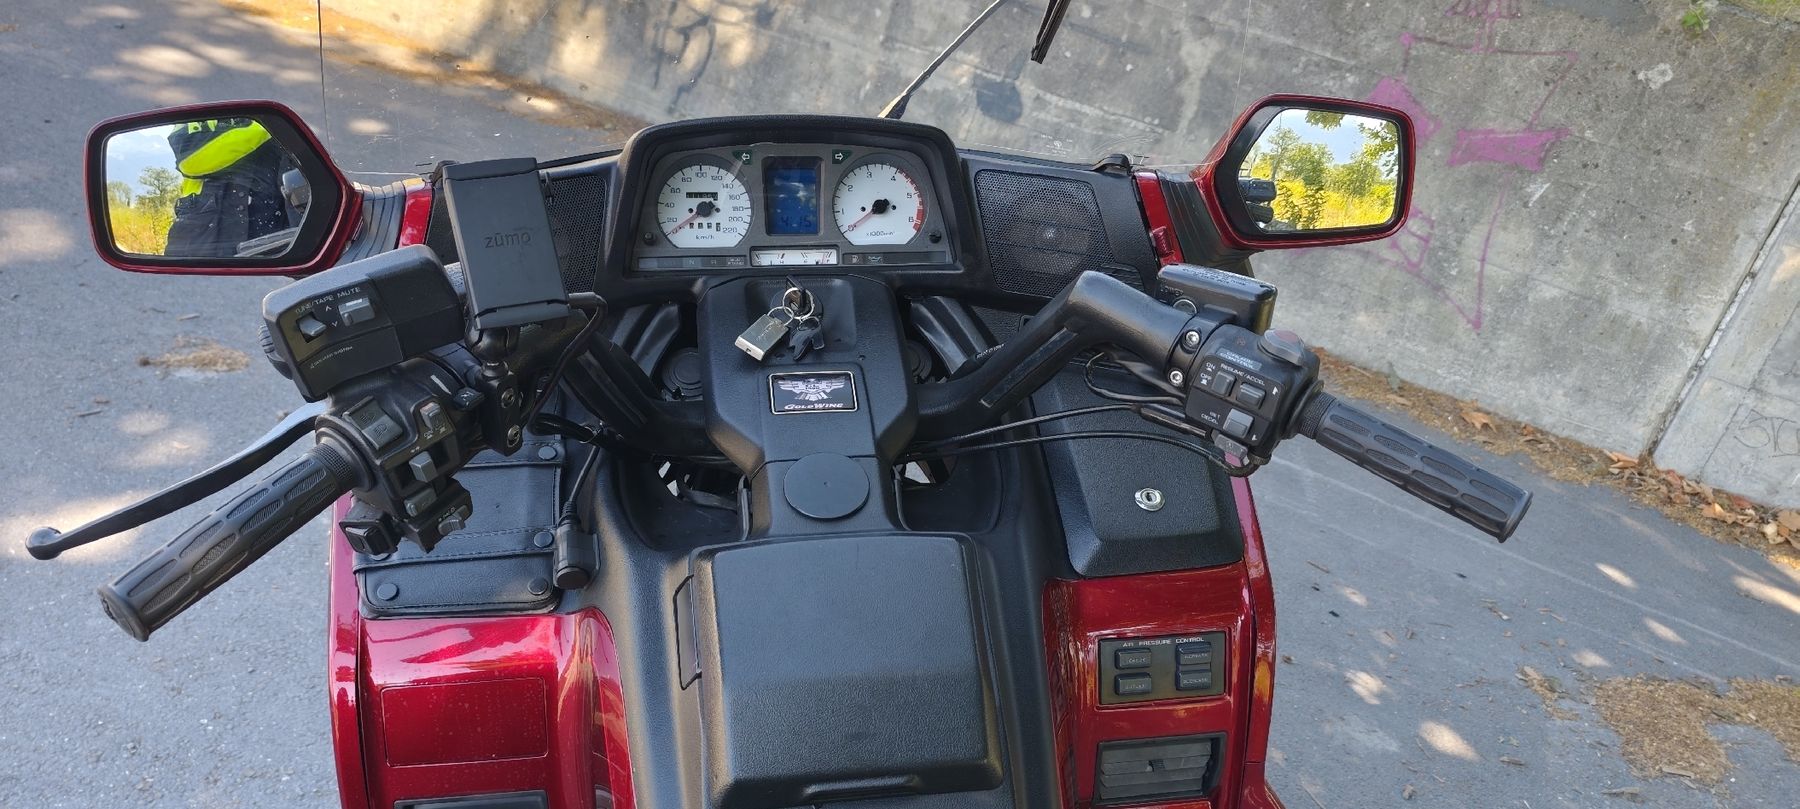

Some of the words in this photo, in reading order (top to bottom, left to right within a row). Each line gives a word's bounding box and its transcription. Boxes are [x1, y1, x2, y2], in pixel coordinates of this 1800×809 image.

[337, 286, 361, 298] MUTE
[1206, 362, 1215, 370] ON
[1200, 372, 1212, 380] OFF
[1175, 636, 1204, 644] CONTROL
